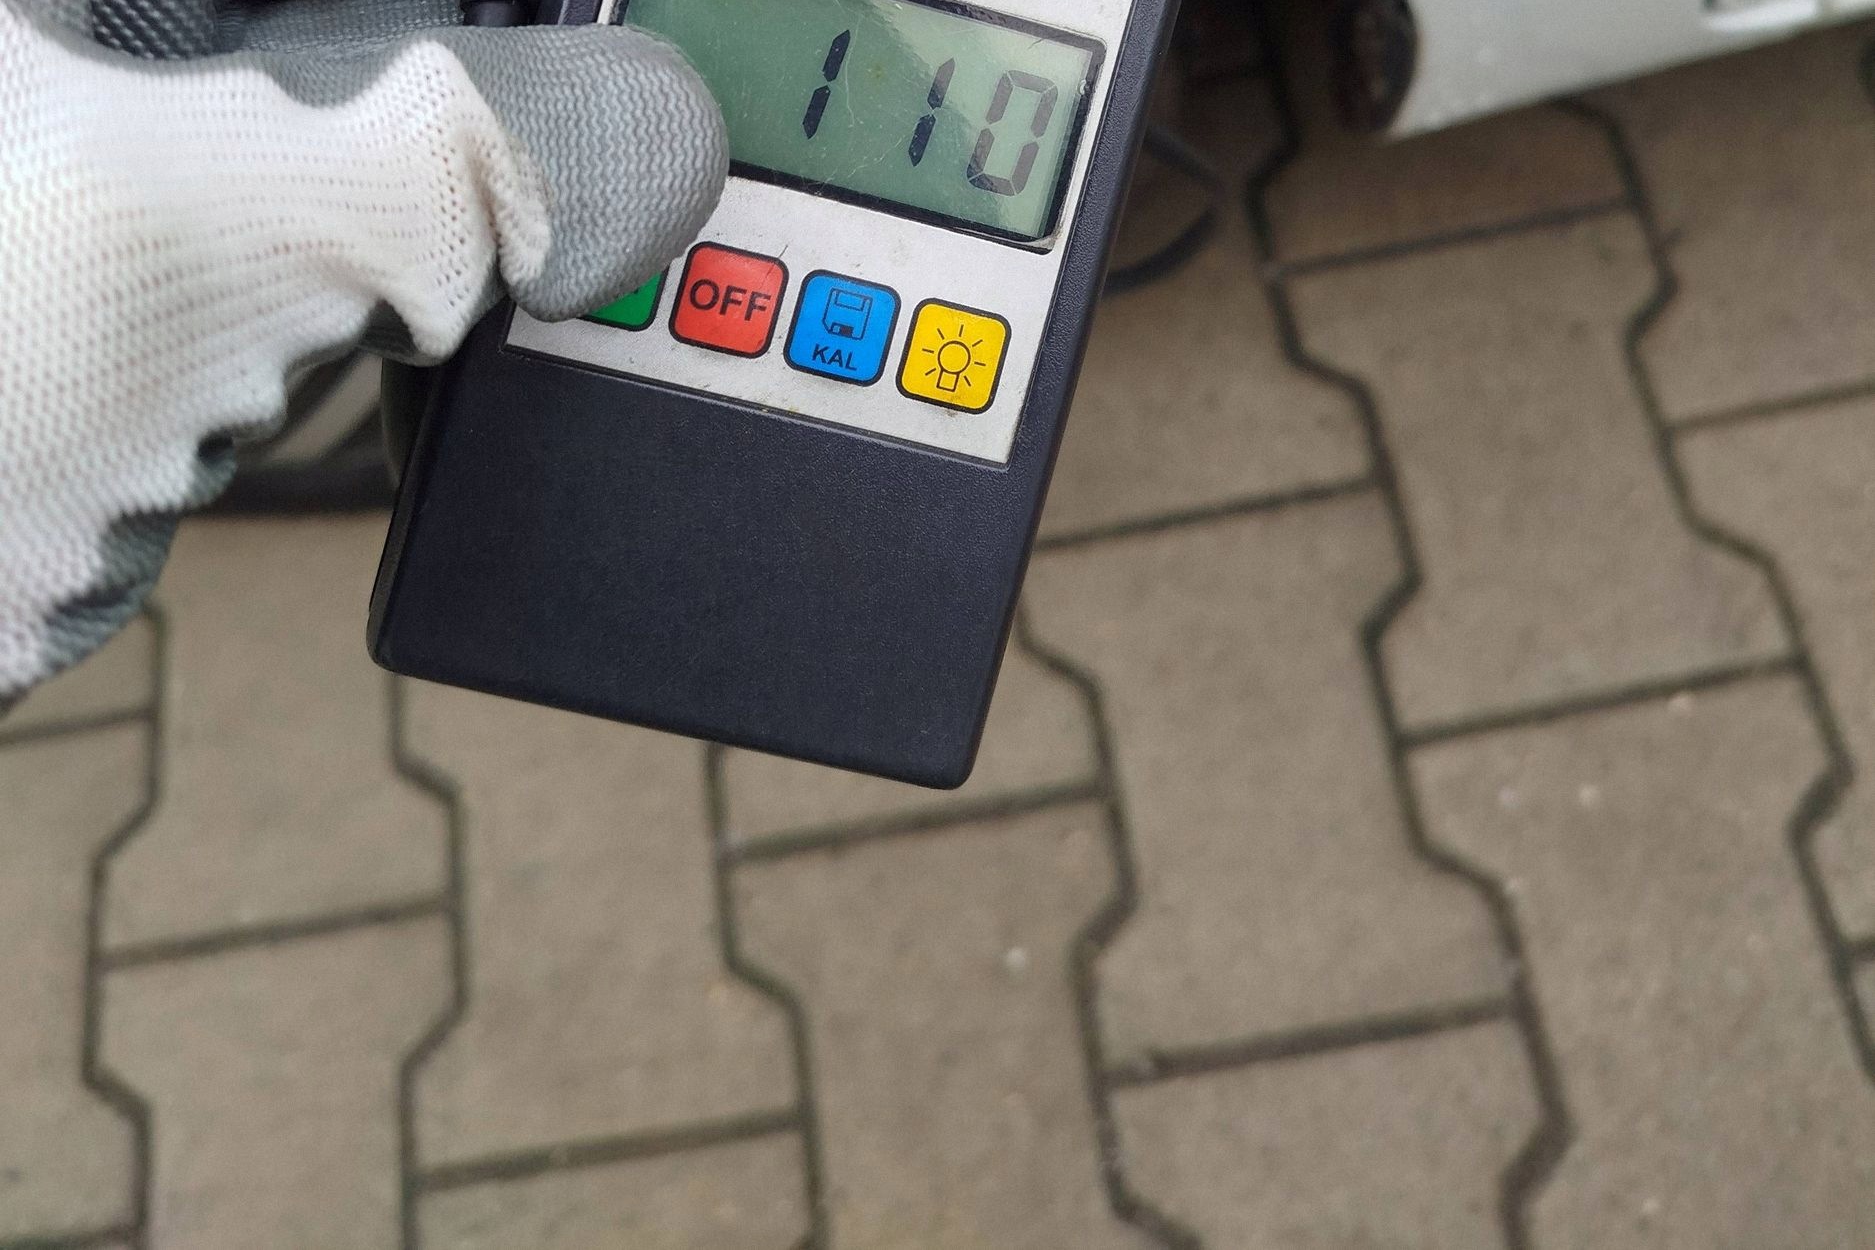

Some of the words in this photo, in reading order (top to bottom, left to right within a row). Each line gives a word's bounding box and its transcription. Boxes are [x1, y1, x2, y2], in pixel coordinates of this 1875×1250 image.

[803, 29, 1058, 197] 110
[689, 278, 772, 322] OFF
[811, 343, 859, 372] KAL
